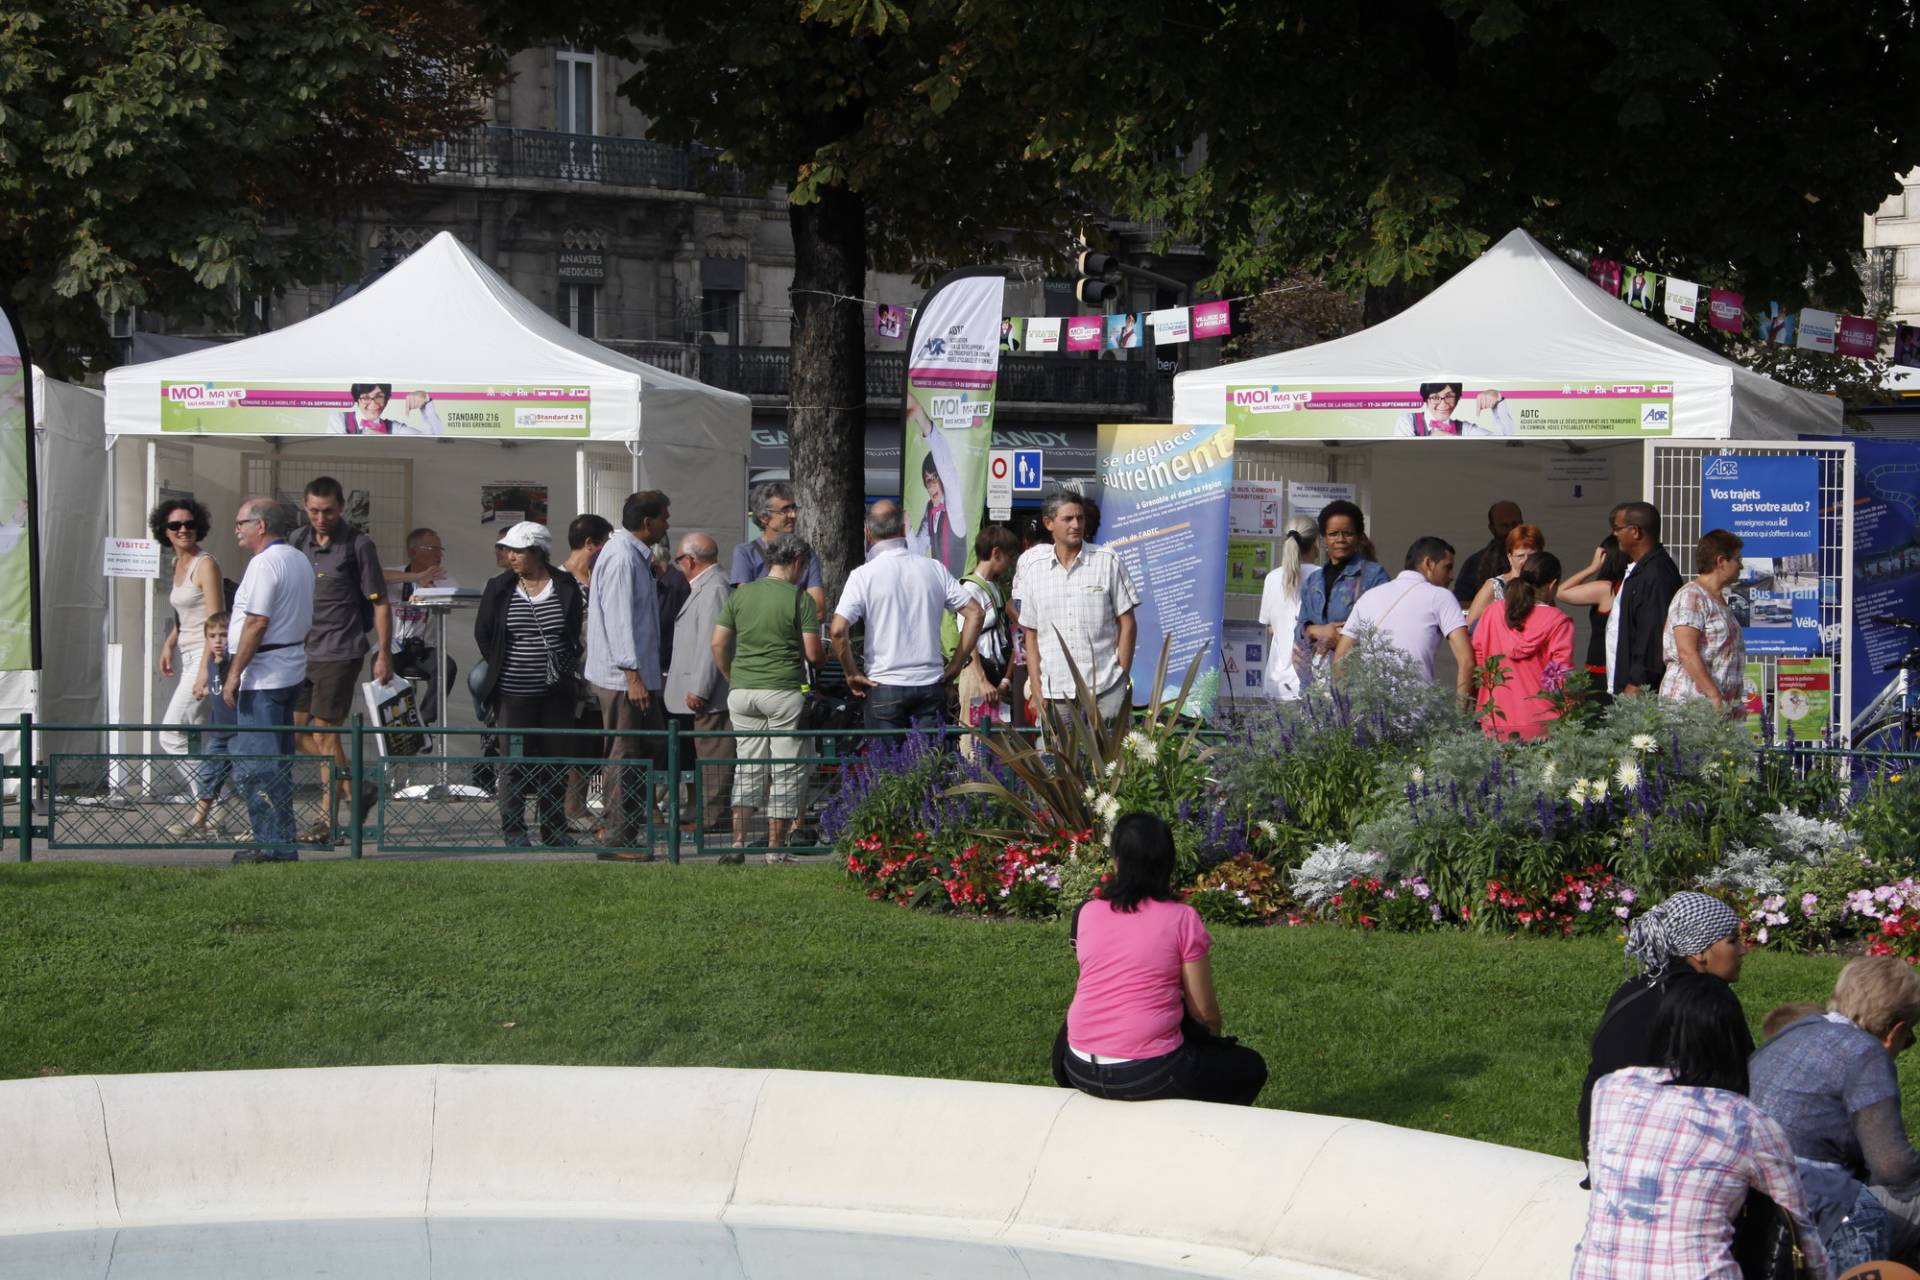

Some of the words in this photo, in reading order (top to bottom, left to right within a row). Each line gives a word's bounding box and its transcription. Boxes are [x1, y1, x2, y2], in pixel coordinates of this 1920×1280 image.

[559, 254, 603, 264] ANALYSES
[558, 267, 604, 277] MEDICALES
[172, 386, 203, 400] MOI
[208, 390, 225, 399] MA
[228, 390, 243, 398] VIE
[1237, 390, 1269, 404] MOI
[1274, 394, 1290, 402] MA
[1292, 393, 1308, 401] VIE
[933, 398, 959, 416] MOI
[973, 403, 989, 414] VIE
[447, 412, 484, 421] STANDARD
[486, 413, 499, 421] 216
[1520, 409, 1539, 418] ADTC
[751, 429, 790, 446] GA
[991, 431, 1070, 447] ANDY
[1102, 456, 1119, 468] se
[1125, 428, 1198, 466] déplacer
[1102, 430, 1233, 491] autrement
[1141, 495, 1169, 509] Grenoble
[1170, 491, 1177, 500] et
[1178, 489, 1192, 498] dans
[1202, 480, 1222, 492] région
[1710, 489, 1729, 499] Vos
[1730, 488, 1761, 502] trajets
[1731, 503, 1754, 512] sans
[1755, 502, 1780, 512] votre
[1781, 502, 1804, 512] auto
[1804, 501, 1811, 512] ?
[1130, 532, 1137, 541] de
[1759, 530, 1769, 538] qui
[116, 541, 150, 549] VISITEZ
[1749, 587, 1771, 599] Bus
[1795, 617, 1818, 628] Vélo
